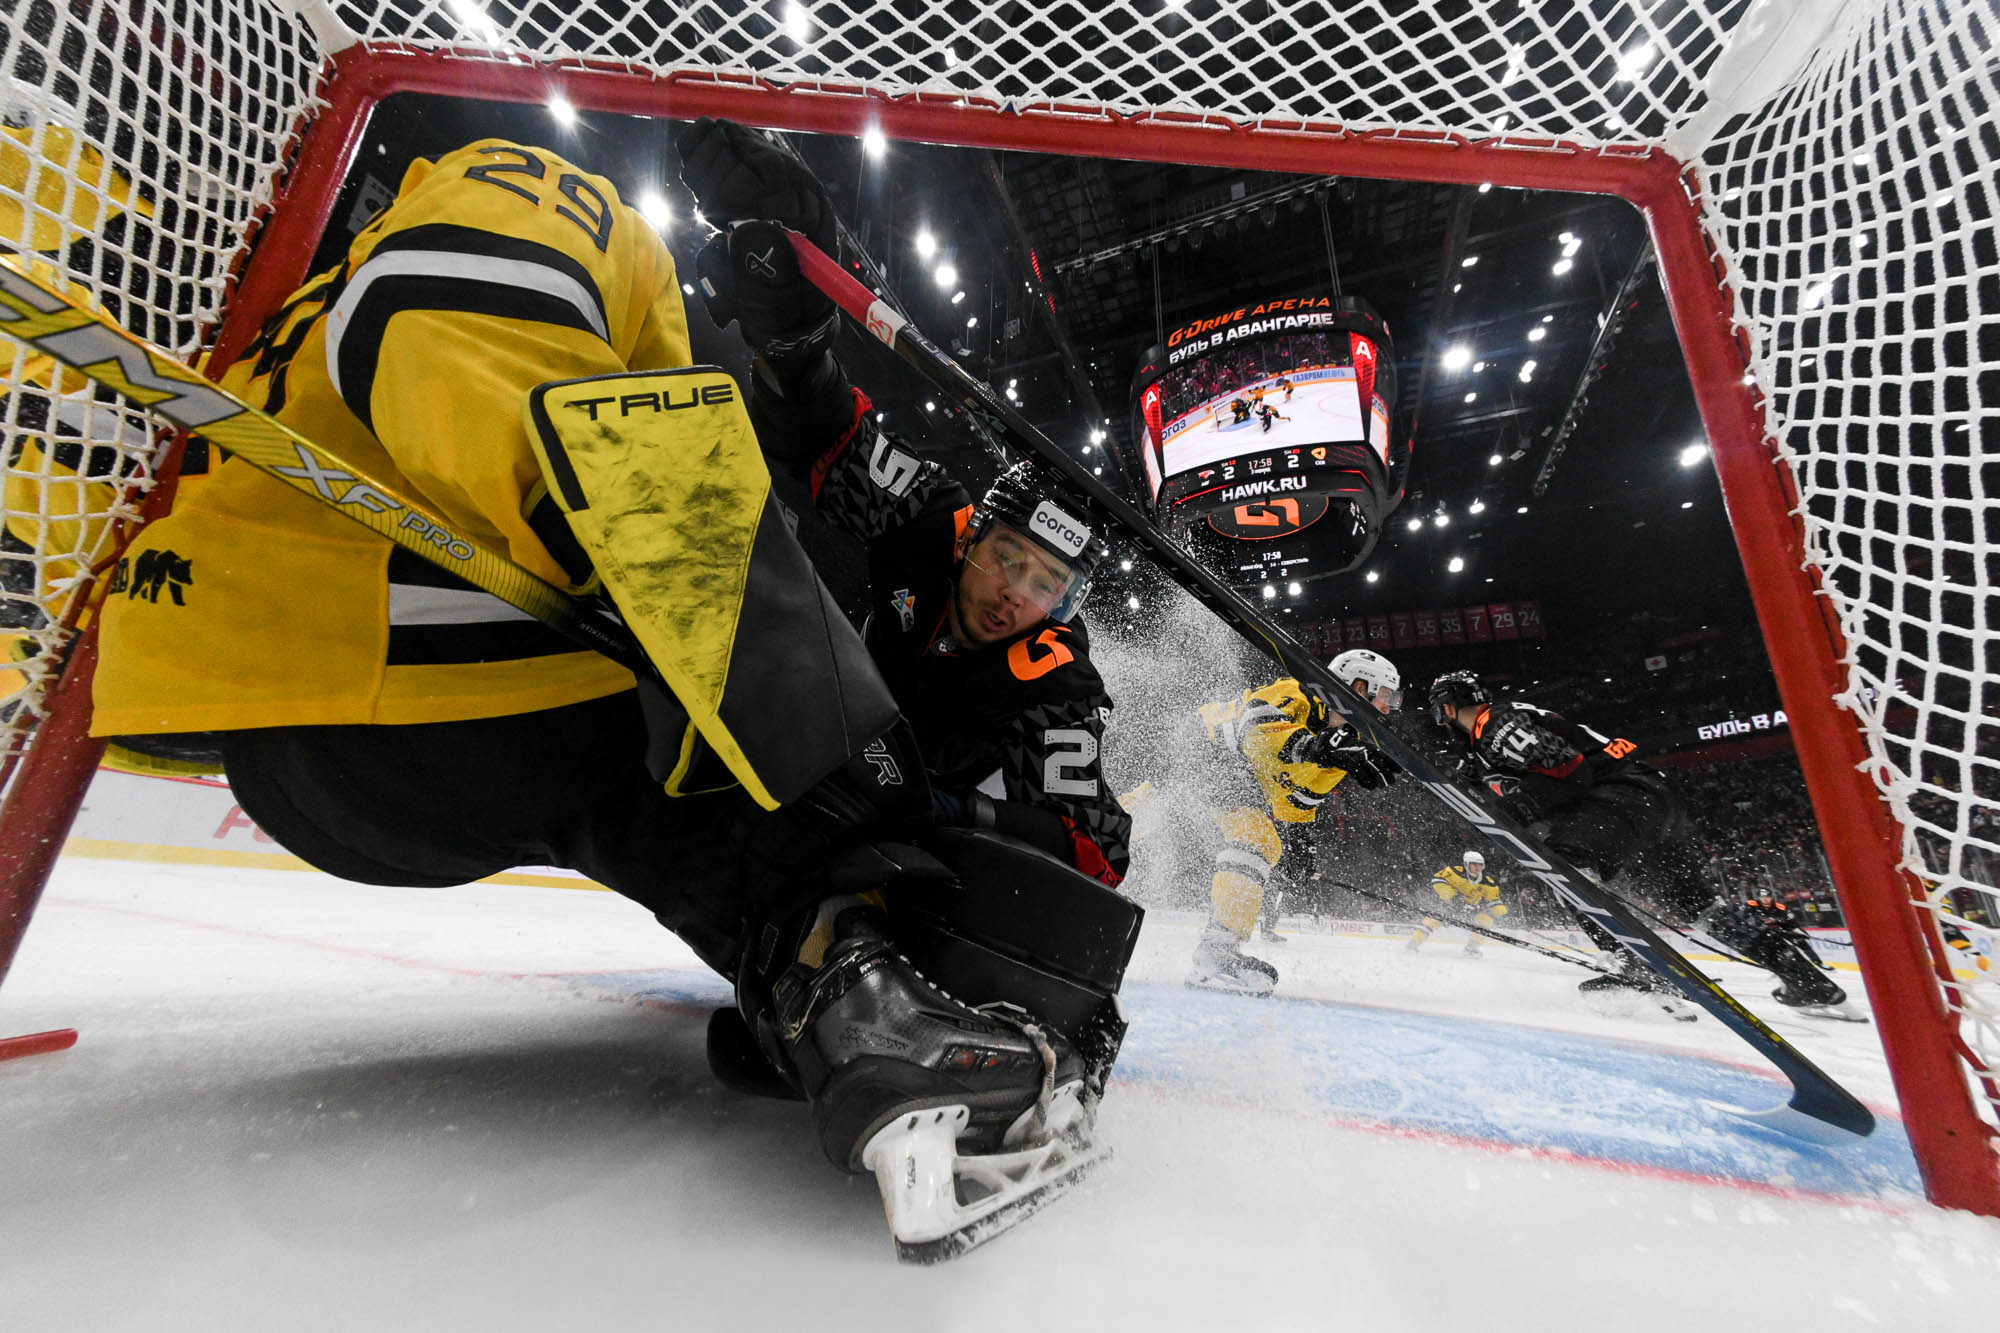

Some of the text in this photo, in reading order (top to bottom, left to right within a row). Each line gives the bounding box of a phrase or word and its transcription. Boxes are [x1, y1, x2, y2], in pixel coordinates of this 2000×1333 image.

[463, 145, 615, 254] 29
[1250, 297, 1331, 316] АРЕНА
[1169, 313, 1334, 364] БУДЬ В АВАНГАРДЕ
[563, 384, 733, 421] TRUE
[1162, 419, 1186, 440] огаз
[1248, 458, 1272, 470] 17:58
[1287, 455, 1299, 468] 2
[1224, 466, 1235, 480] 2
[1221, 475, 1307, 502] HAWK.RU
[270, 443, 474, 561] XF PRO
[1036, 511, 1083, 548] согаз
[1262, 551, 1281, 561] 17:58
[1260, 568, 1287, 579] 2 2
[1417, 619, 1436, 635] 55
[1441, 617, 1461, 633] 35
[1472, 616, 1481, 631] 7
[1495, 612, 1514, 628] 29
[1518, 611, 1540, 627] 24
[1491, 721, 1516, 752] FONBET
[1698, 719, 1752, 740] БУДЬ
[1751, 714, 1770, 729] В
[1502, 728, 1539, 763] 14
[1043, 729, 1098, 797] 2
